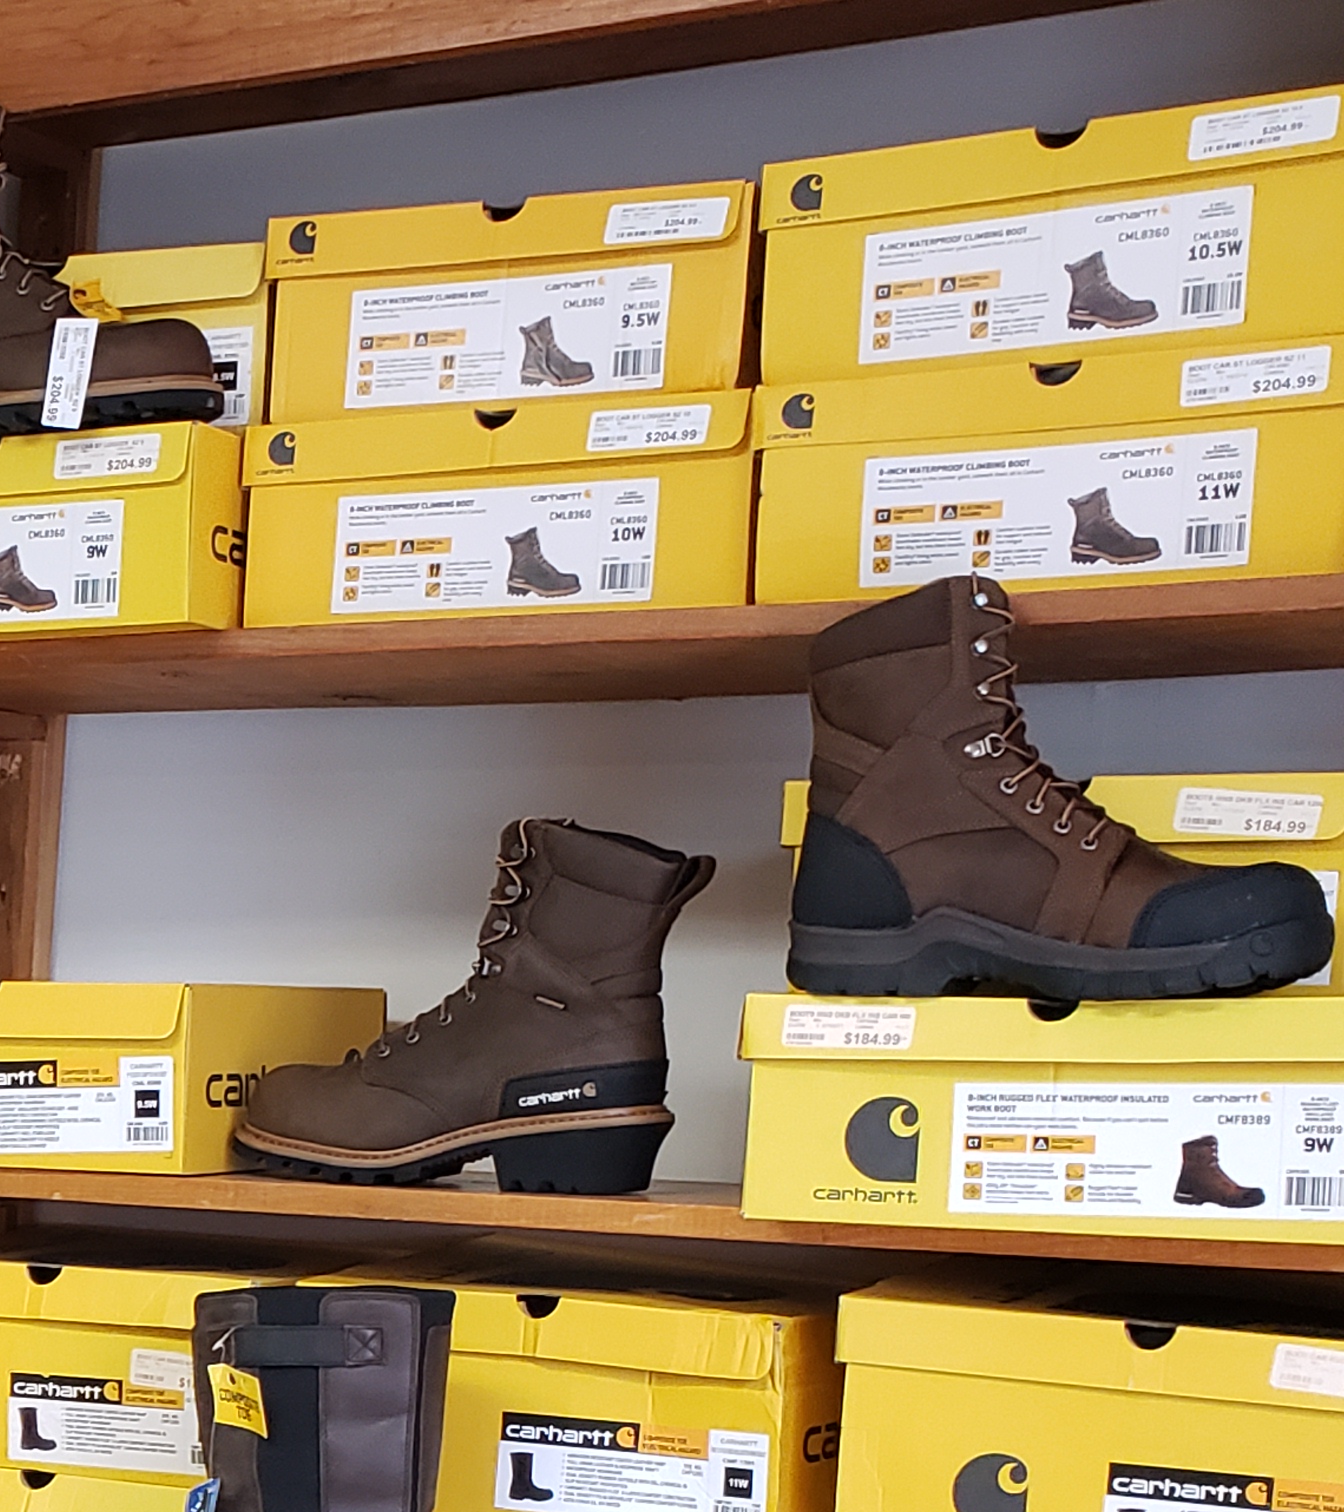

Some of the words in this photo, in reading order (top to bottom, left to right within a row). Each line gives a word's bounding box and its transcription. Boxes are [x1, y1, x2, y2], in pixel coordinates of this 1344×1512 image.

[1094, 208, 1159, 224] carhartt
[1118, 227, 1170, 243] CML8360
[1187, 240, 1243, 263] 10.5W
[544, 279, 596, 291] carhartt
[620, 311, 661, 329] 9.5W
[1252, 375, 1317, 395] $204.99
[644, 430, 698, 444] $204.99
[1099, 447, 1163, 461] carhartt
[106, 457, 152, 471] $204.99
[1008, 458, 1030, 469] BOOT
[1122, 466, 1174, 480] CML8360
[530, 493, 583, 503] carhartt
[1198, 483, 1240, 501] 11W
[11, 511, 56, 522] carhartt
[611, 526, 646, 543] 10W
[86, 545, 109, 559] 9W
[1244, 818, 1307, 833] $184.99
[843, 1031, 902, 1047] $184.99
[518, 1088, 581, 1107] carhartt
[1061, 1095, 1118, 1104] WATERPROOF
[1121, 1095, 1169, 1104] INSULATED
[1192, 1093, 1258, 1103] carhartt
[966, 1105, 992, 1113] WORK
[994, 1105, 1017, 1113] BOOT
[1218, 1114, 1271, 1126] CMF8389
[1303, 1137, 1334, 1153] 9W
[13, 1380, 102, 1399] carhartt
[505, 1422, 613, 1446] carhartt
[1112, 1475, 1242, 1503] carhartt
